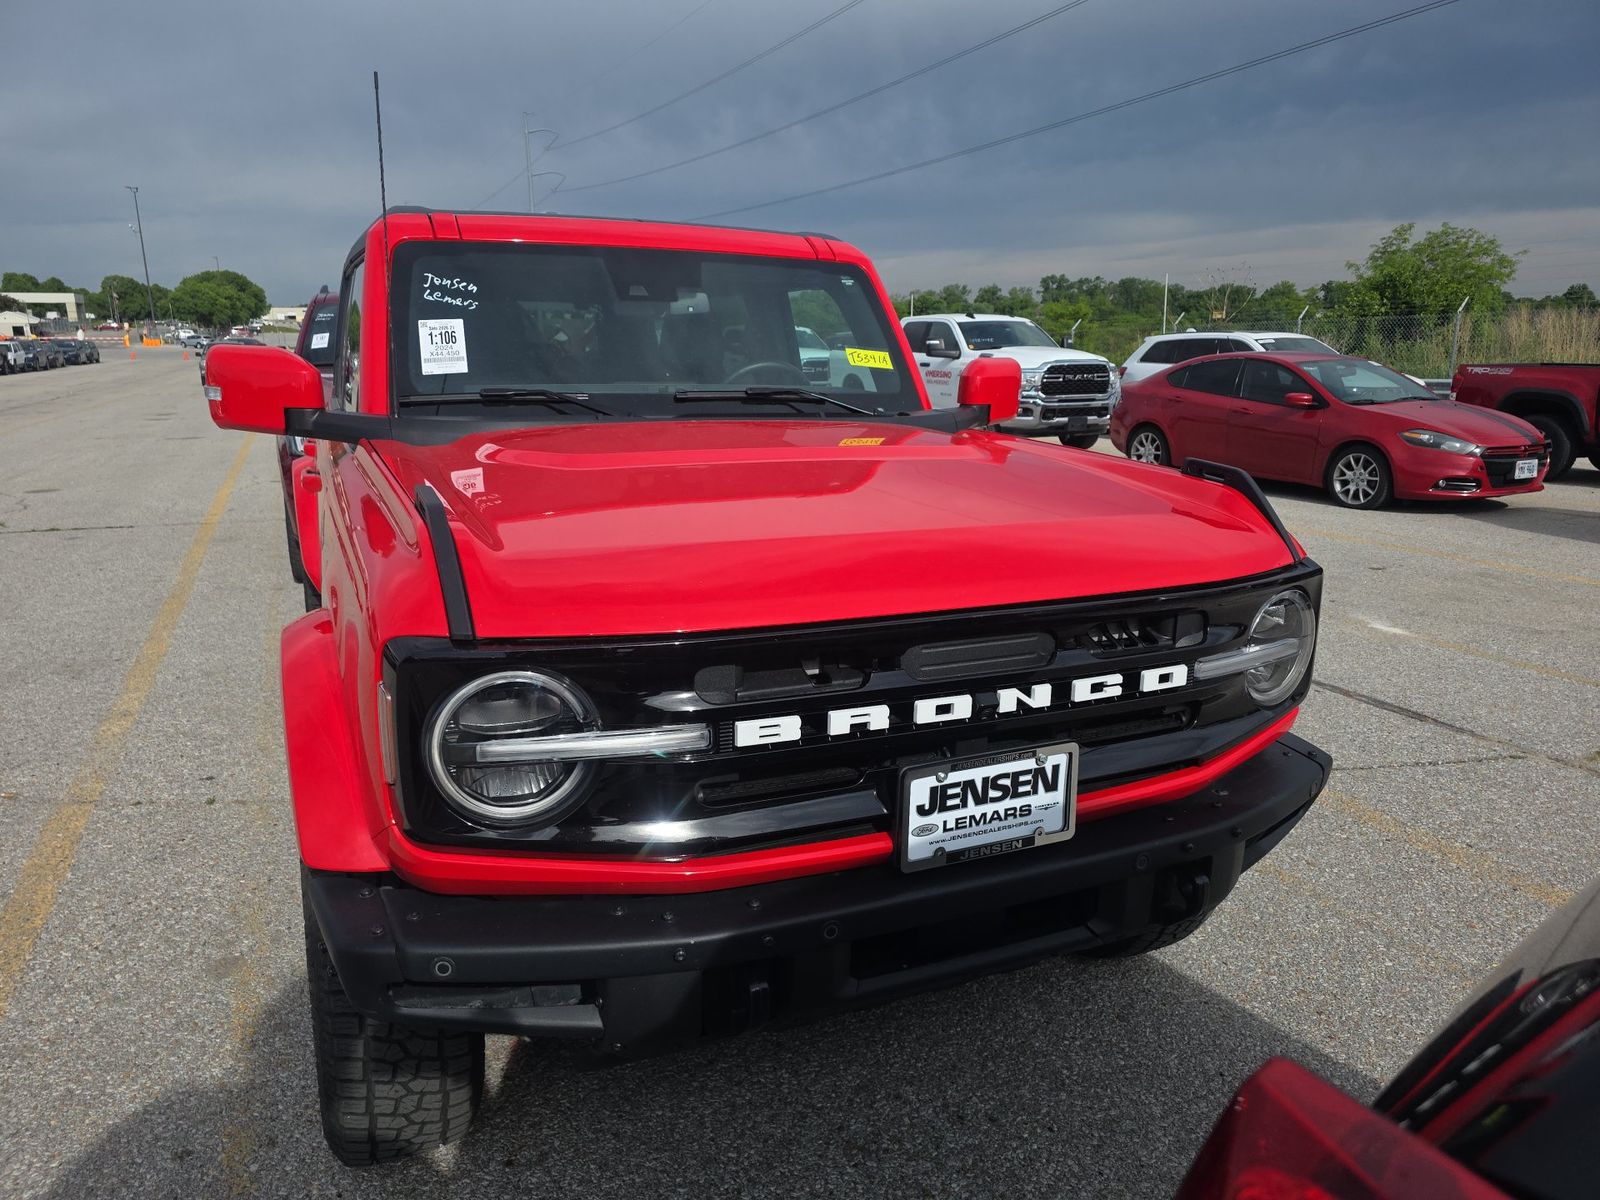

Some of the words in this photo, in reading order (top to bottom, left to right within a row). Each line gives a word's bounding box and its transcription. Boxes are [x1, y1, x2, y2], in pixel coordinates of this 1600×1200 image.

[423, 273, 478, 293] Jensen
[428, 330, 457, 345] 1:106
[734, 664, 1188, 749] BRONCO
[916, 763, 1061, 817] JENSEN
[914, 825, 936, 836] Ford
[942, 803, 1033, 834] LEMARS
[928, 818, 1044, 845] www.JENSENDEALERSHIPS.com
[960, 839, 1023, 860] JENSEN
